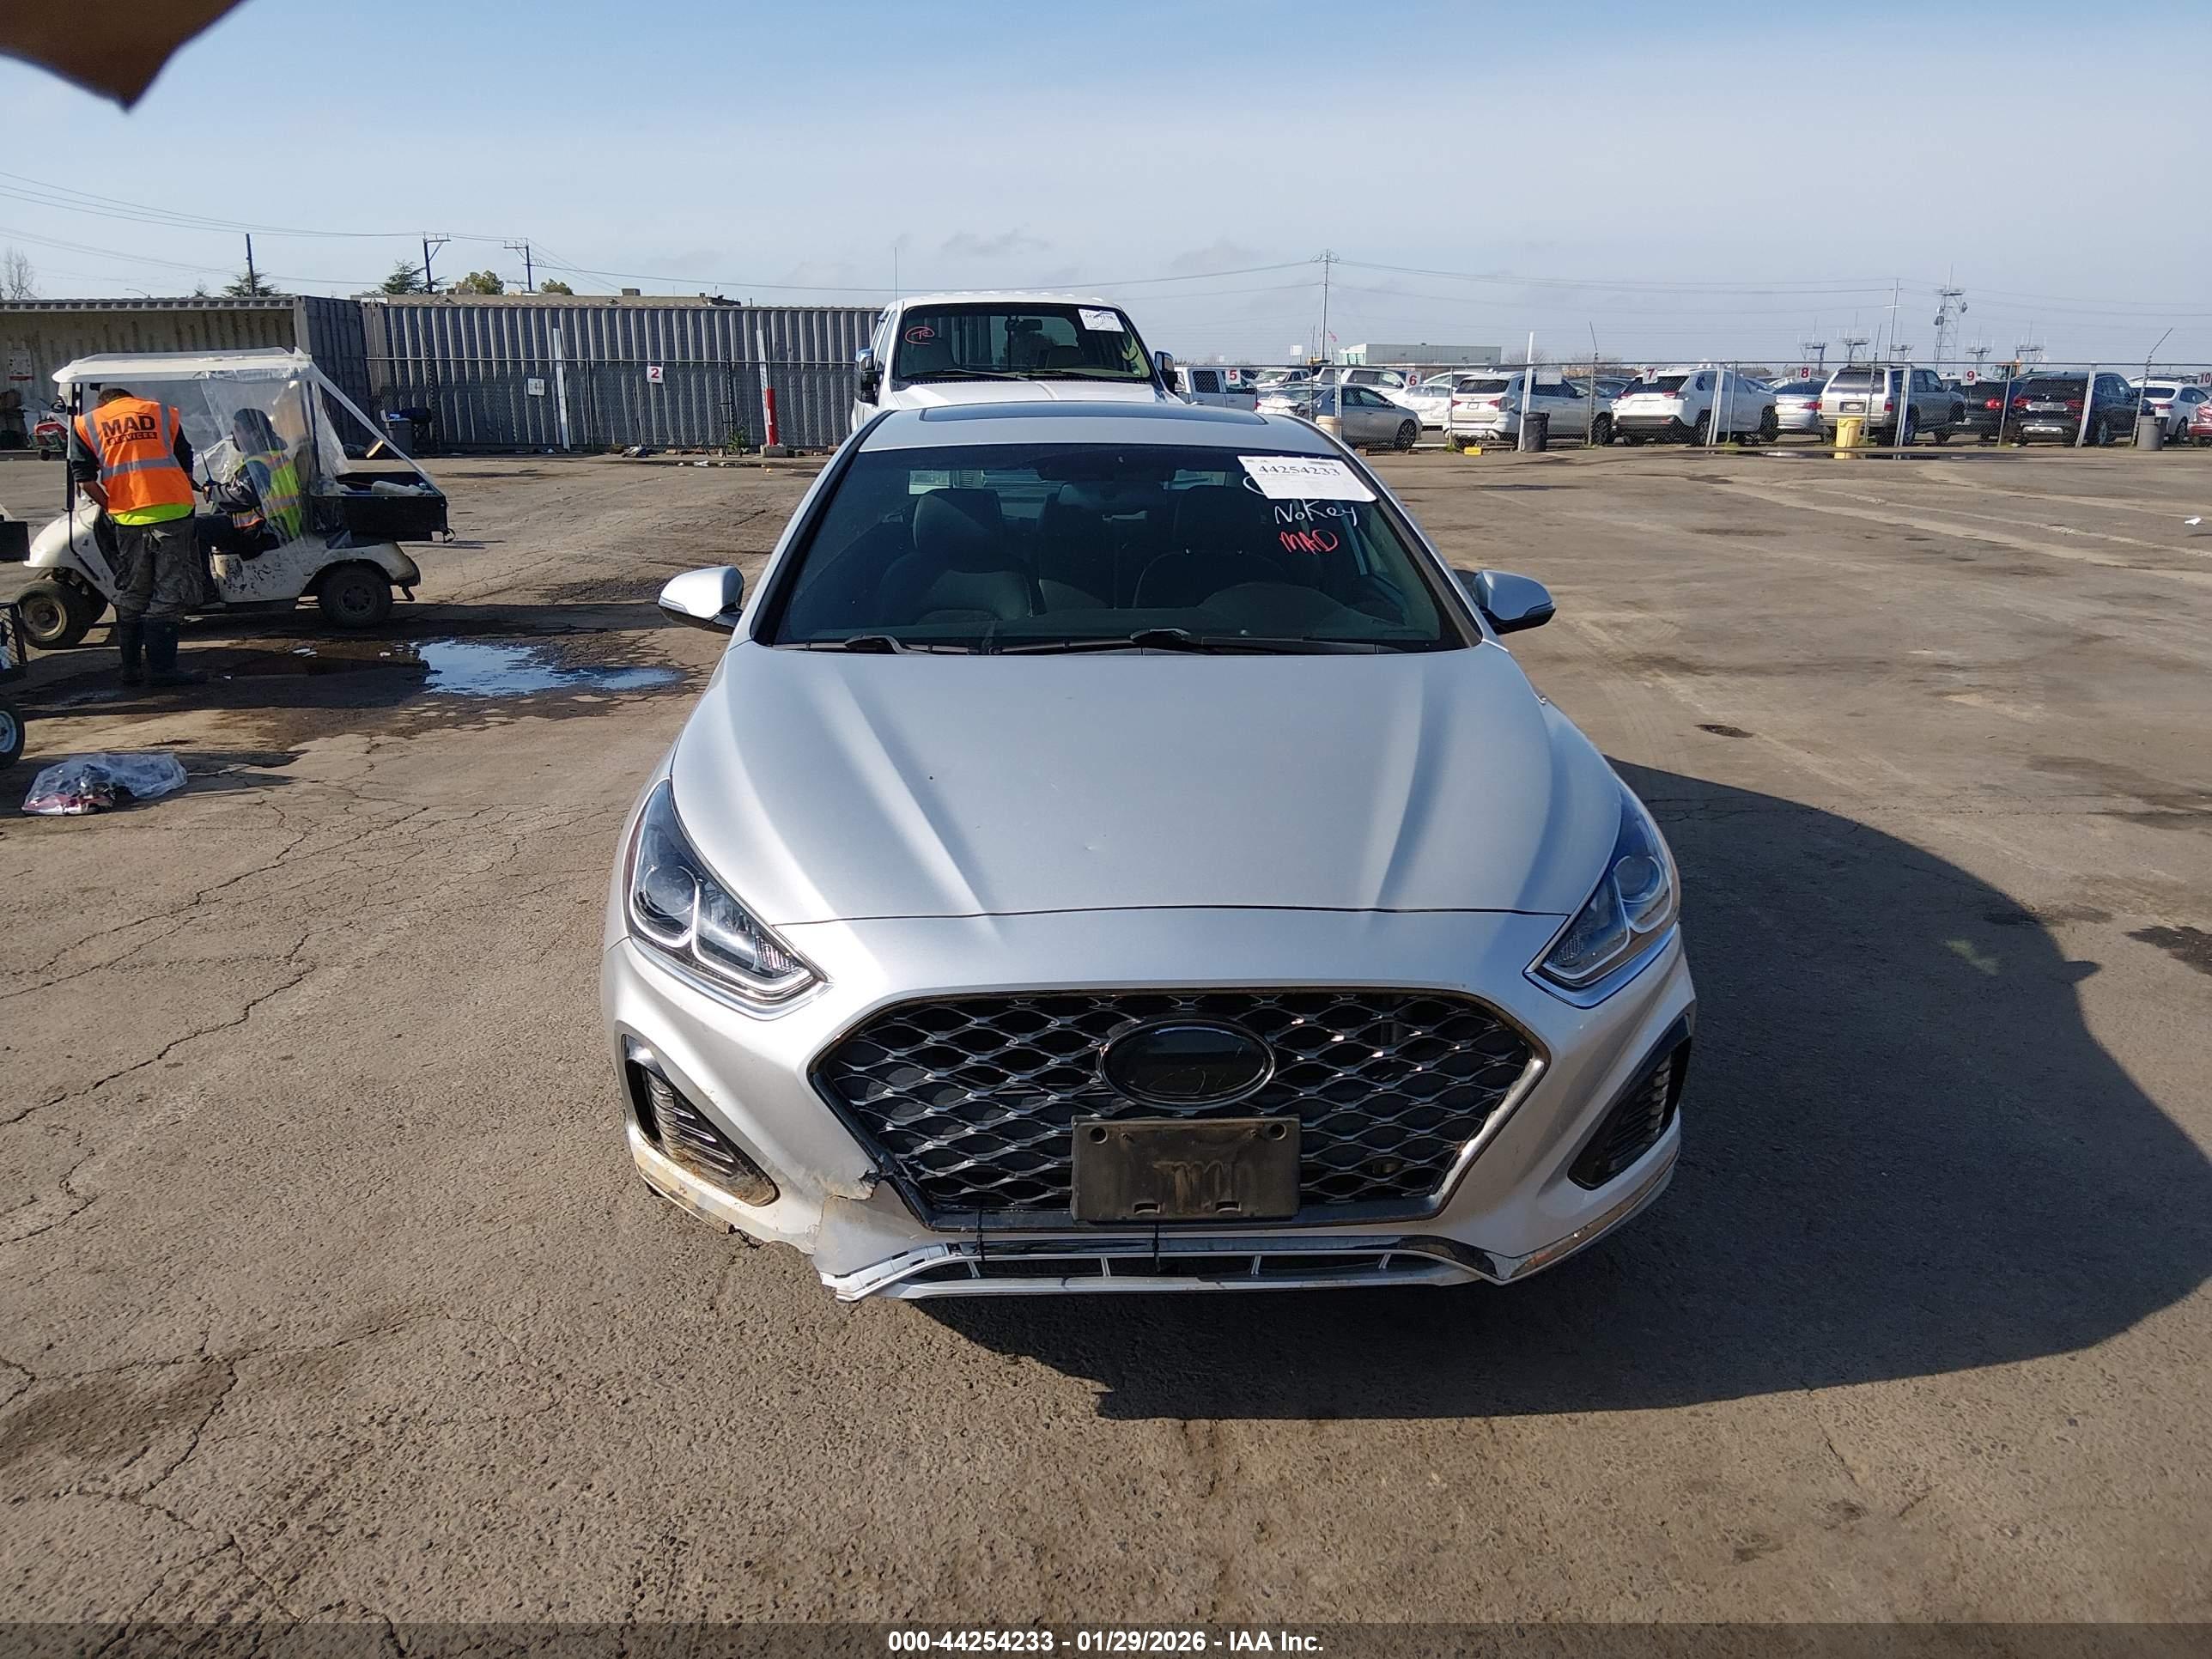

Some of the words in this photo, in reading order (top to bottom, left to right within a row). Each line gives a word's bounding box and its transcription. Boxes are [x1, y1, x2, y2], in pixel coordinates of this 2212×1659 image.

[650, 368, 660, 379] 2
[1229, 369, 1237, 380] 5
[1647, 368, 1656, 380] 7
[1801, 367, 1809, 379] 8
[1966, 370, 1975, 381] 9
[2200, 373, 2211, 383] 10
[1408, 374, 1418, 386] 6
[100, 415, 155, 439] MAD
[107, 432, 157, 446] SERVICES
[1258, 465, 1340, 477] 44254233
[1279, 529, 1339, 555] MAD
